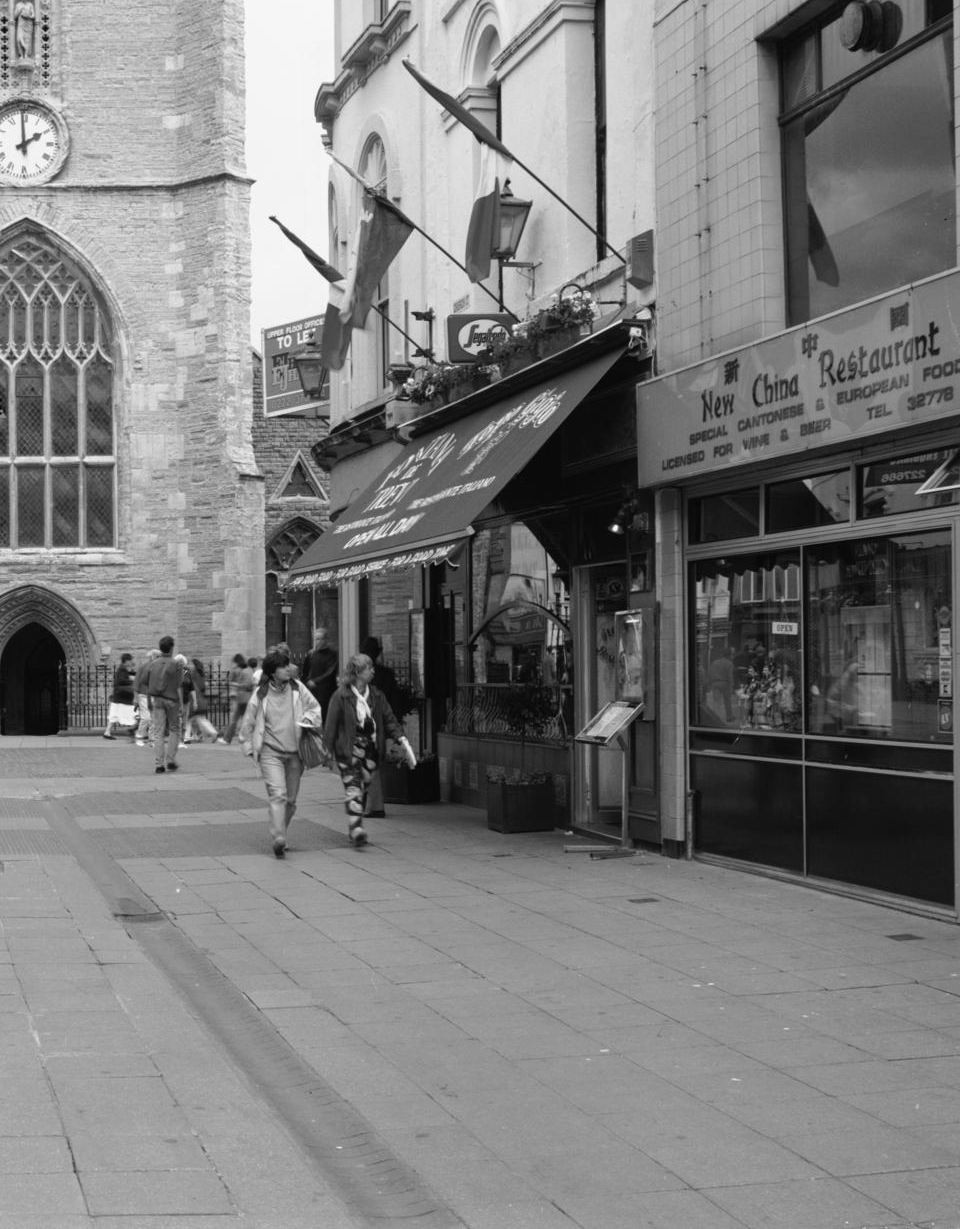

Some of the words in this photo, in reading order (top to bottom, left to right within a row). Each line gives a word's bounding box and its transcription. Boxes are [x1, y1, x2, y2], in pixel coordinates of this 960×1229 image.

[303, 317, 326, 329] OFFICE
[276, 334, 292, 349] TO
[701, 389, 735, 422] New
[752, 372, 799, 407] China
[818, 322, 940, 388] Restaurant
[689, 425, 728, 446] SPECIAL
[738, 403, 804, 433] CANTONESE
[836, 373, 910, 406] EUROPEAN
[662, 451, 705, 471] LICENSED
[713, 443, 733, 459] FOR
[742, 435, 770, 452] WINE
[800, 418, 831, 438] BEER
[866, 403, 893, 421] TEL
[343, 526, 379, 550] OPEN
[371, 520, 396, 541] ALL
[776, 623, 793, 632] OPEN
